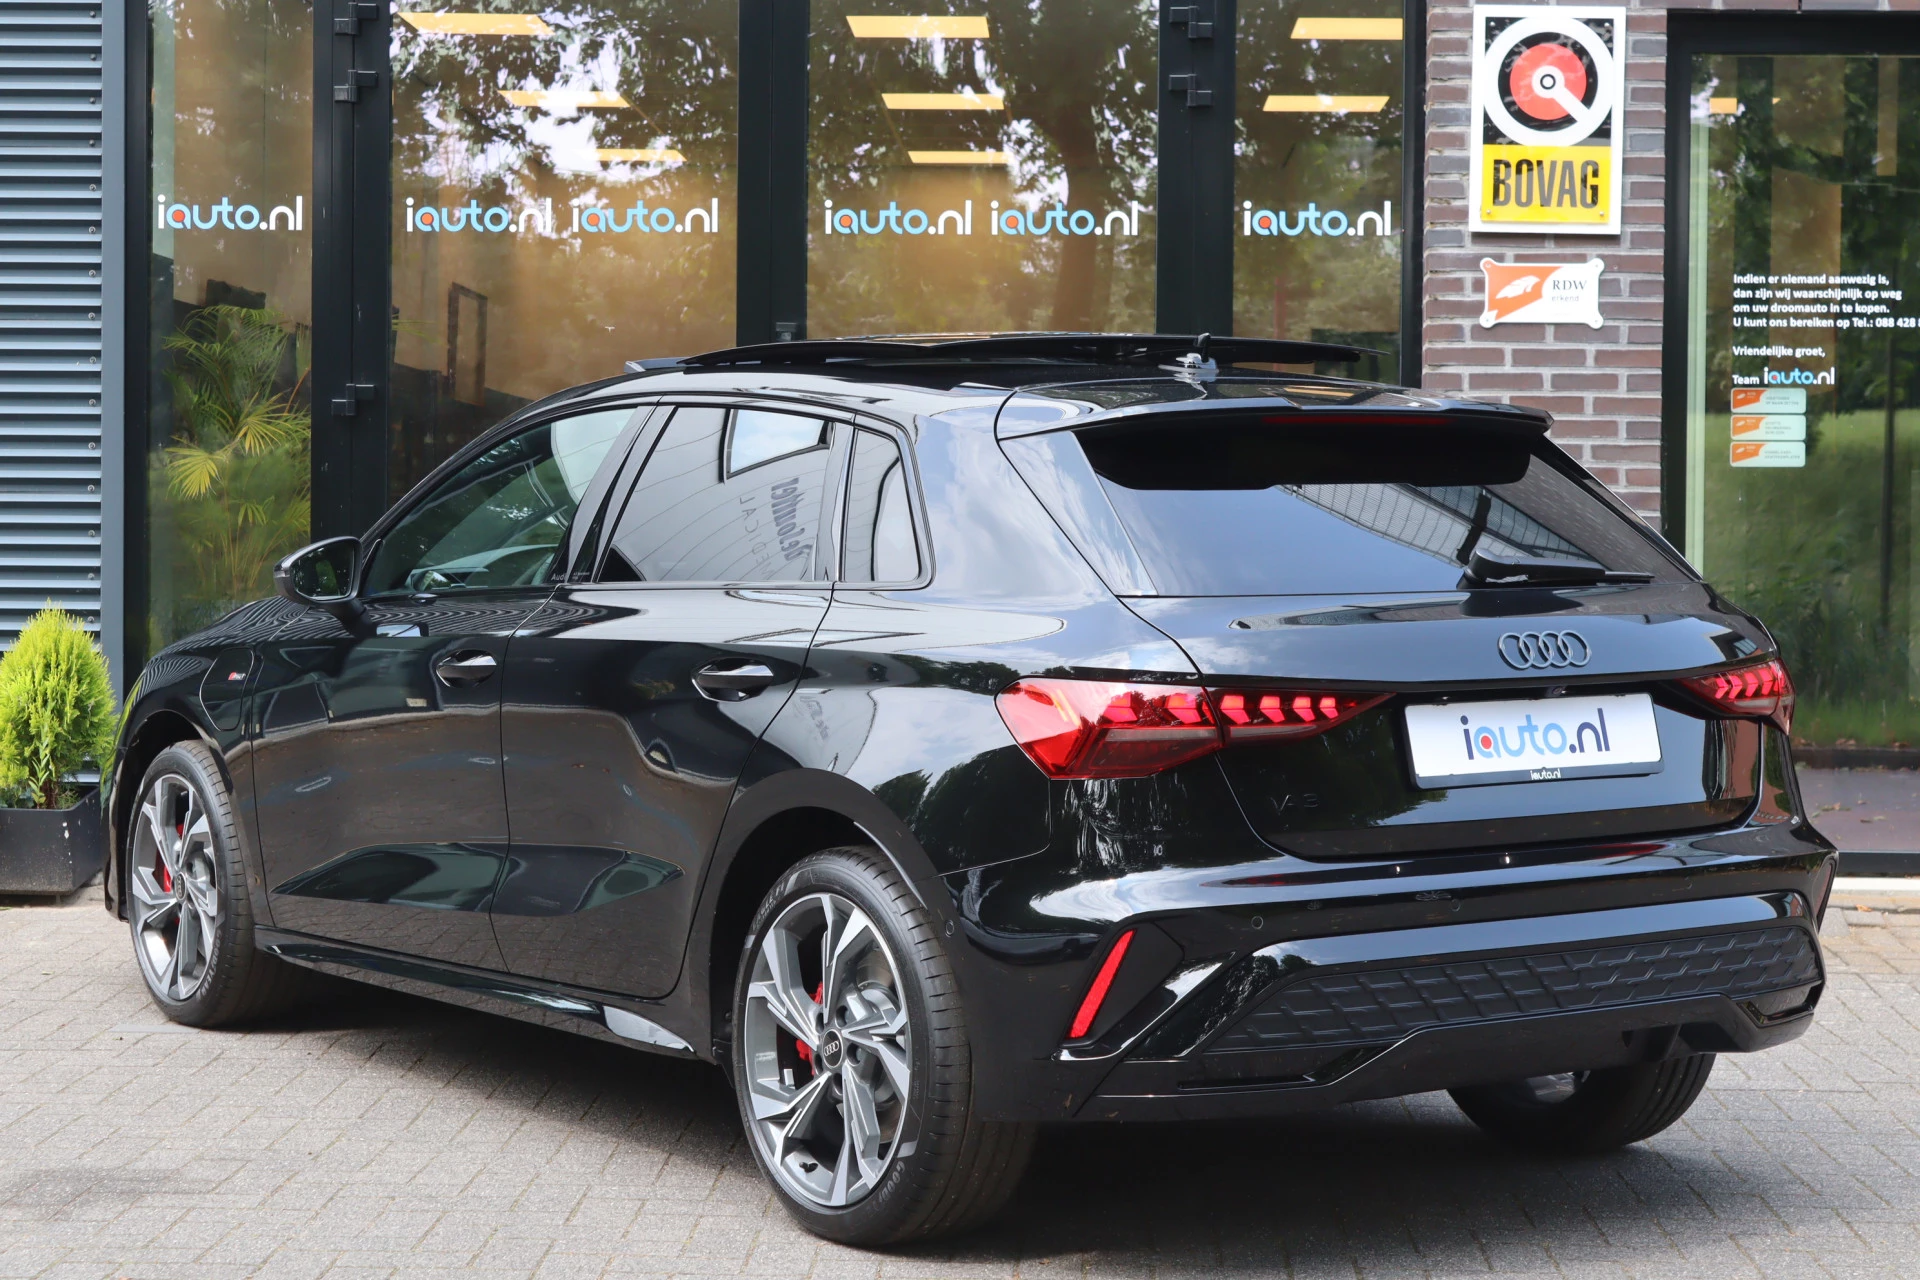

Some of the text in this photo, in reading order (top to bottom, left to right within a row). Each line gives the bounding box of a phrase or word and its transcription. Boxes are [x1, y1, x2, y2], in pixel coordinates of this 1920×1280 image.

[1492, 158, 1600, 209] BOVAG
[157, 194, 303, 232] iauto.nl
[405, 197, 553, 233] iauto.nl
[572, 197, 719, 233] iauto.nl
[824, 199, 973, 236] iauto.nl
[990, 200, 1138, 237] iauto.nl
[1242, 200, 1392, 237] iauto.nl
[1552, 279, 1588, 291] RDW
[1733, 273, 1890, 287] Indien er niemand aanwezig is,
[1551, 294, 1580, 302] erkend
[1733, 288, 1903, 301] dan zijn wij waarschijnlijk op weg
[1733, 302, 1890, 315] om uw droomauto in te kopen.
[1733, 317, 1742, 327] U
[1743, 317, 1768, 328] kunt
[1769, 318, 1788, 328] ons
[1789, 317, 1835, 328] bereiken
[1836, 319, 1851, 330] op
[1852, 317, 1874, 328] Tel.:
[1875, 317, 1895, 328] 088
[1896, 317, 1917, 328] 428
[1732, 345, 1826, 358] Vriendelijke groet,
[1732, 366, 1836, 385] Team iauto.nl
[1459, 707, 1611, 761] iauto.nl
[1530, 768, 1562, 780] iauto.nl
